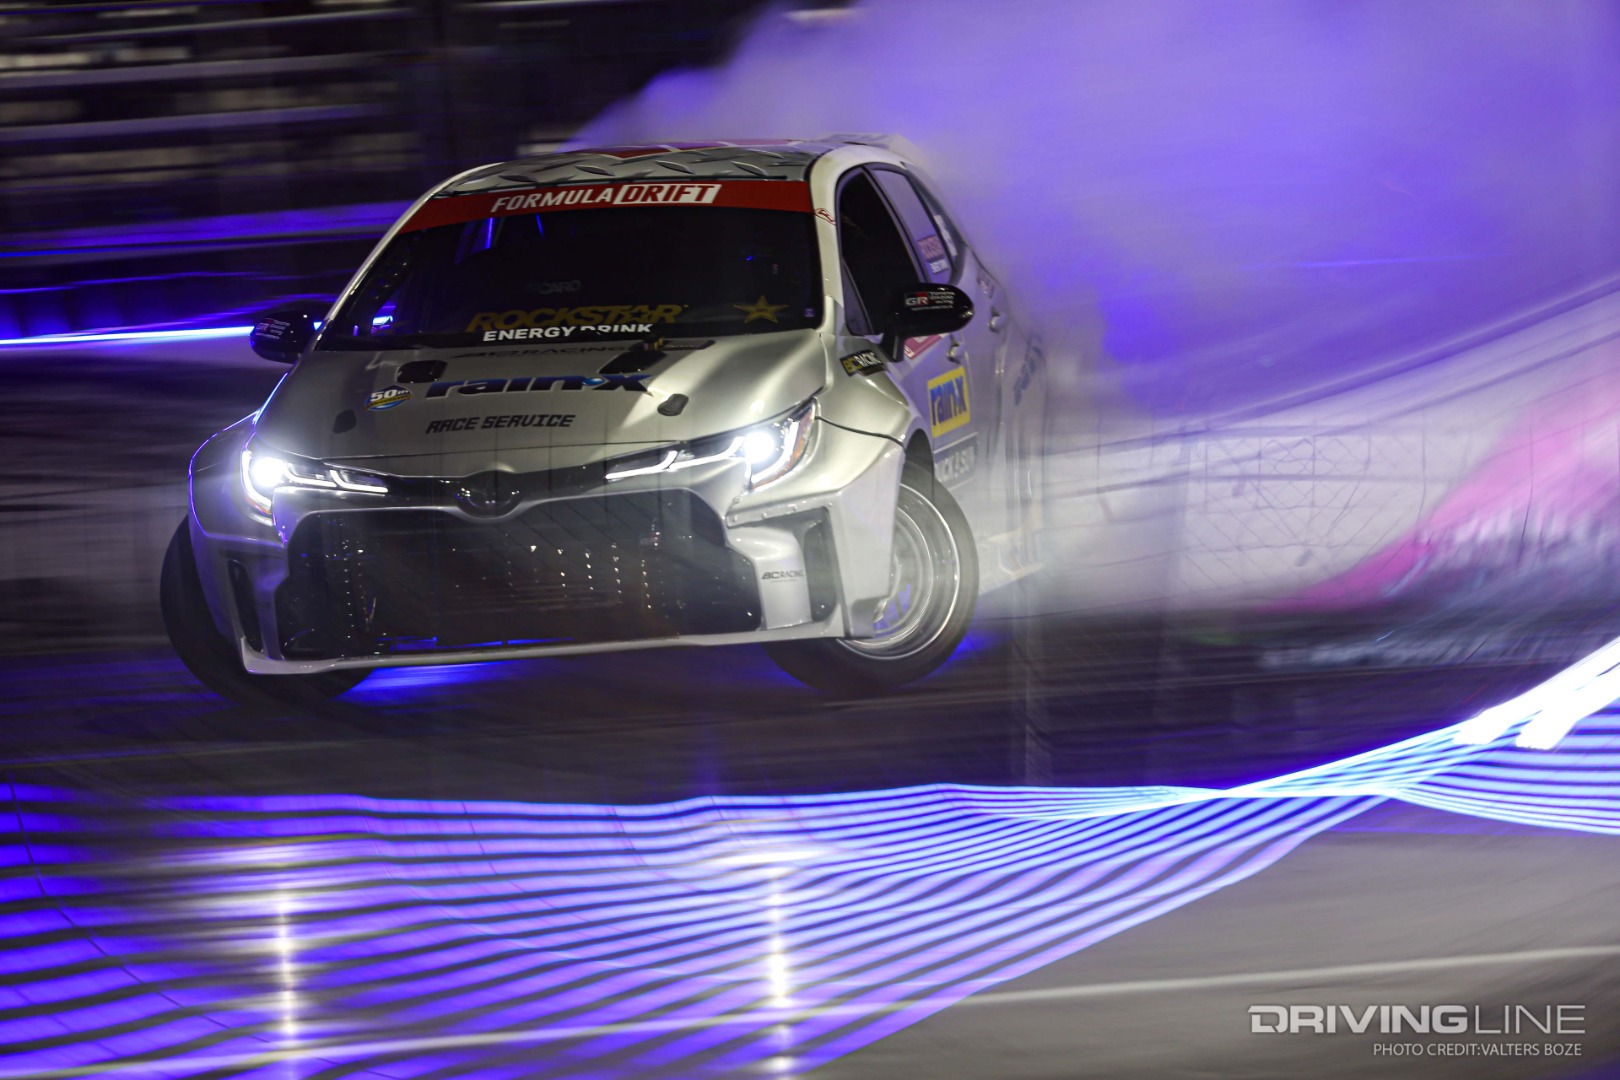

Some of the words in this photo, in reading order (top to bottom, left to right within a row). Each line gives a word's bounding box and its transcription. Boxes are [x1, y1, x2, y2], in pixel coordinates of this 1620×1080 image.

[490, 187, 614, 213] FORMULA
[622, 185, 714, 204] DRIFT
[905, 297, 929, 306] GR
[465, 304, 683, 333] ROCKSTAR
[482, 326, 577, 342] ENERGY
[425, 416, 478, 434] RACE
[481, 415, 576, 430] SERVICE
